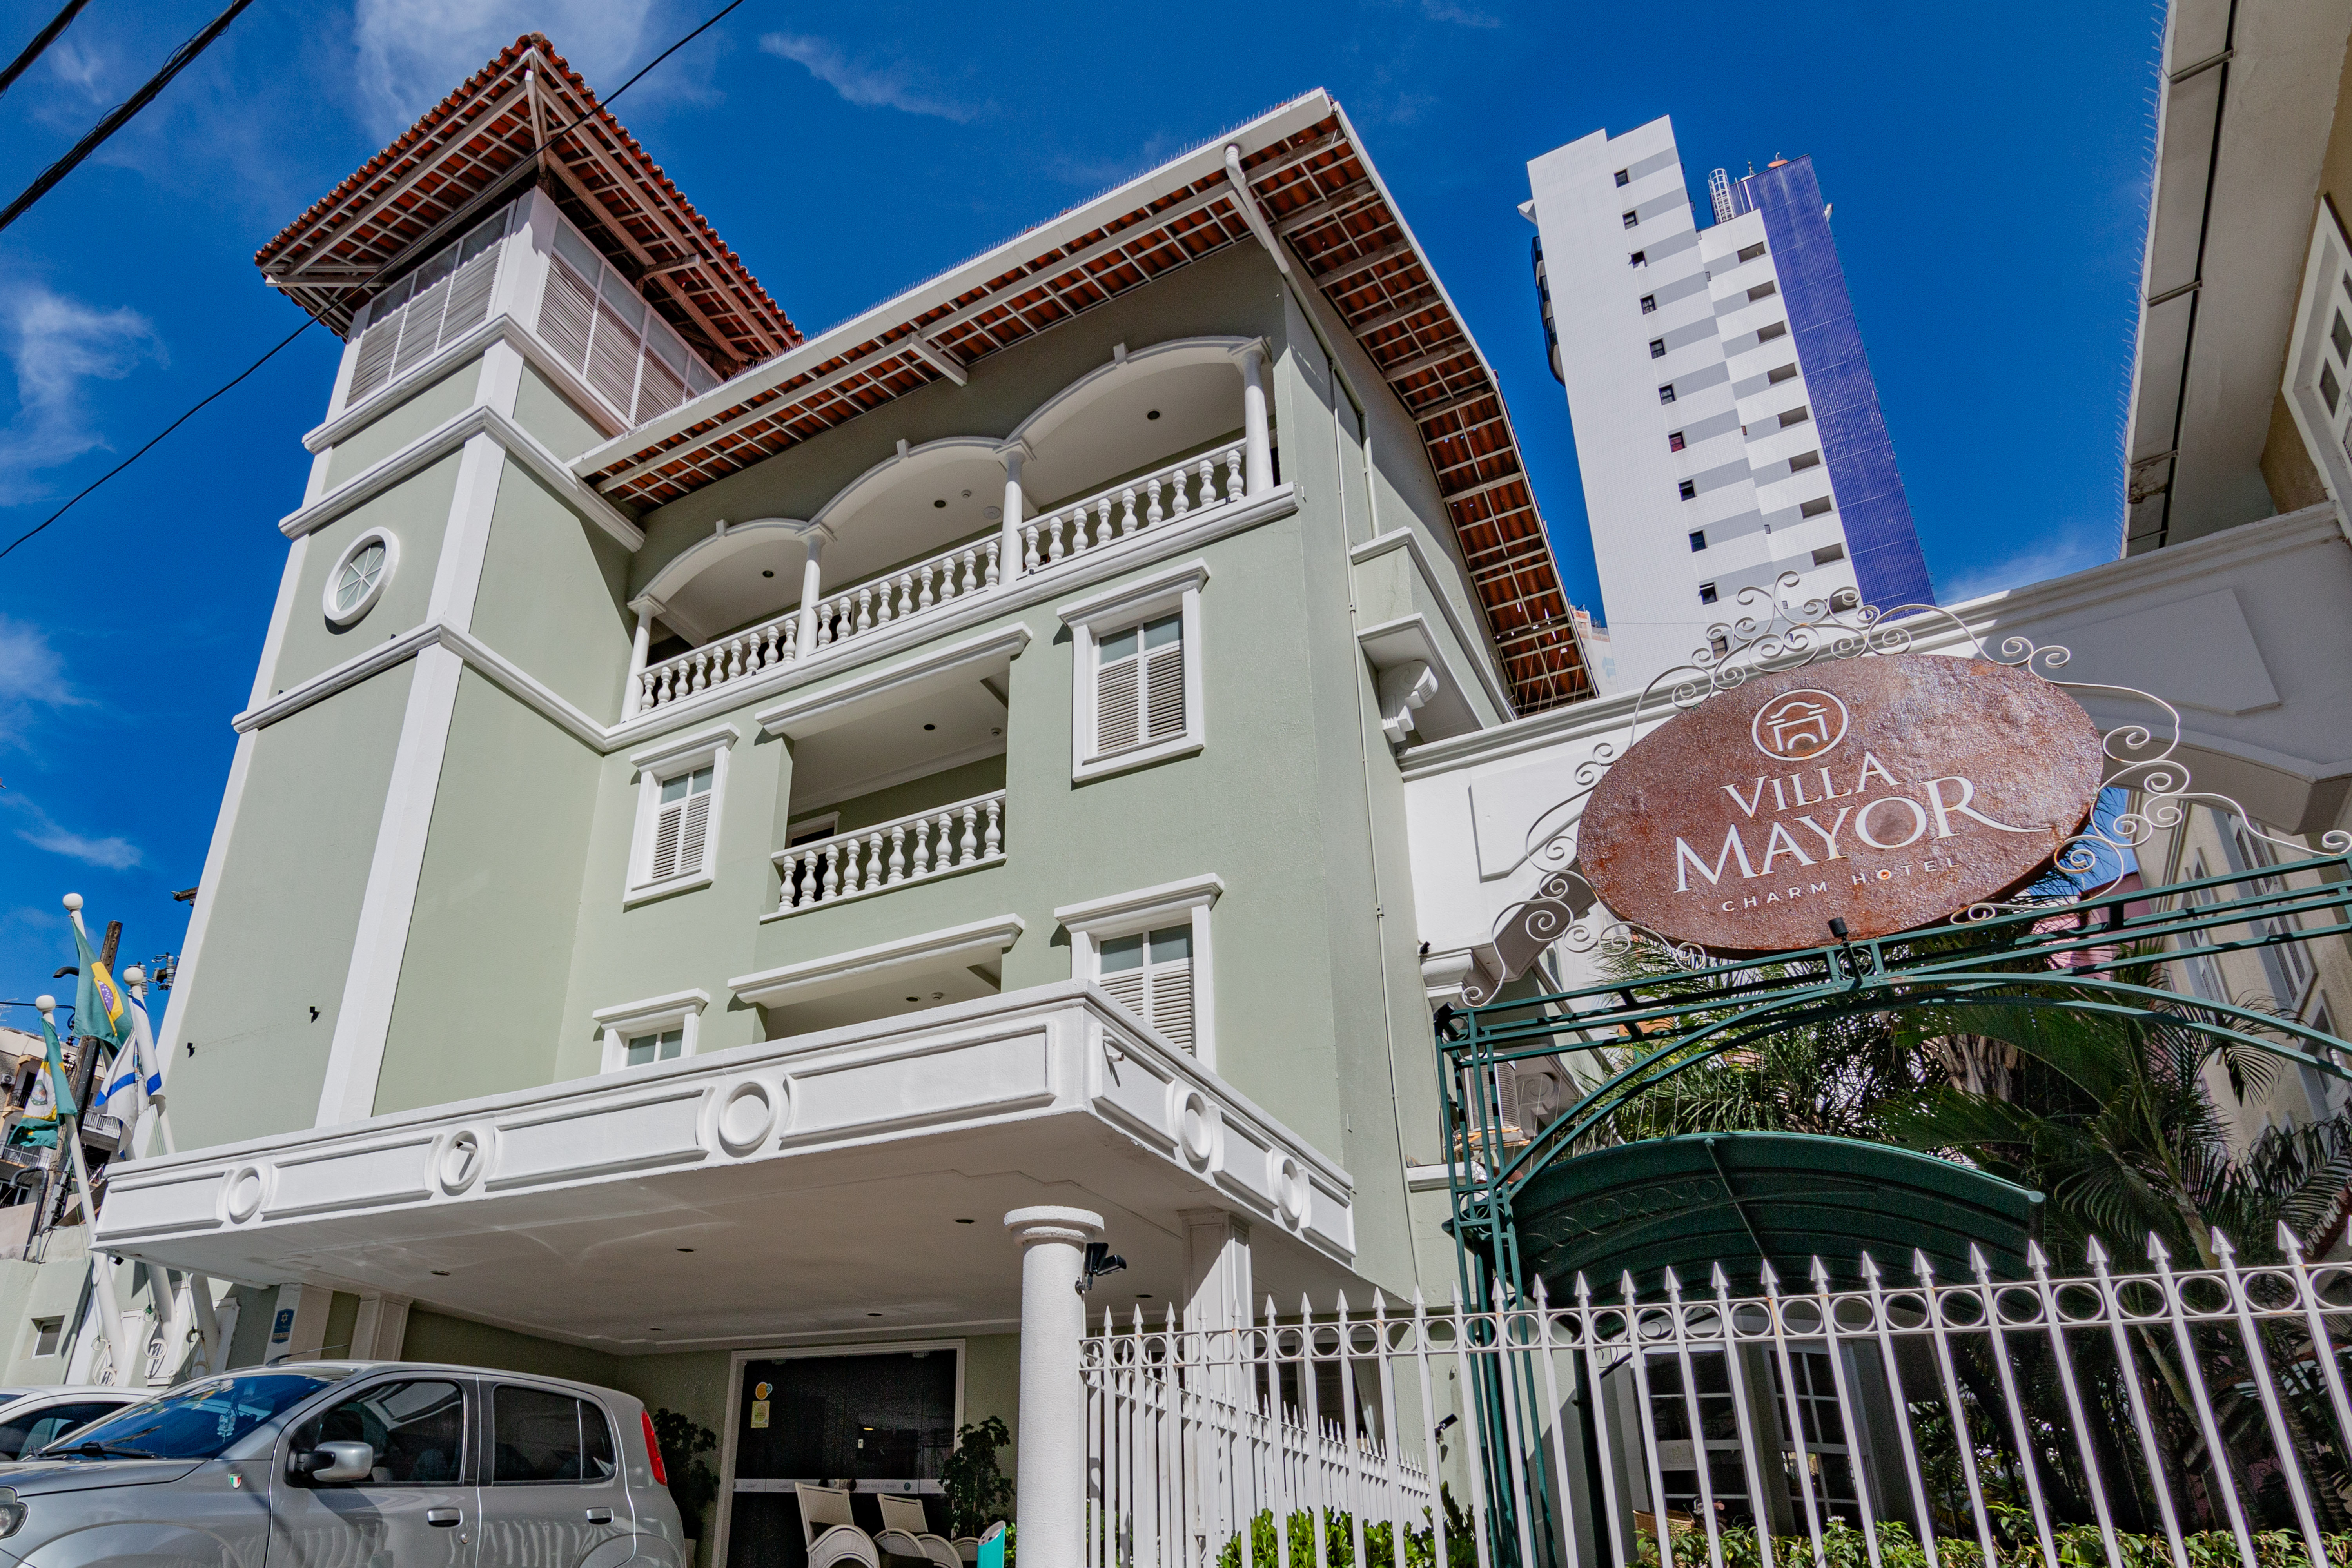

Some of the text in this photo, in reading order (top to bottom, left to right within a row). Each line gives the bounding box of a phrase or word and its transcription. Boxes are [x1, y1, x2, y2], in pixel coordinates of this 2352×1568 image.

[1720, 751, 1904, 818] VILLA
[1673, 776, 2053, 893] MAYOR
[1722, 857, 1960, 912] CHARM HOTEL
